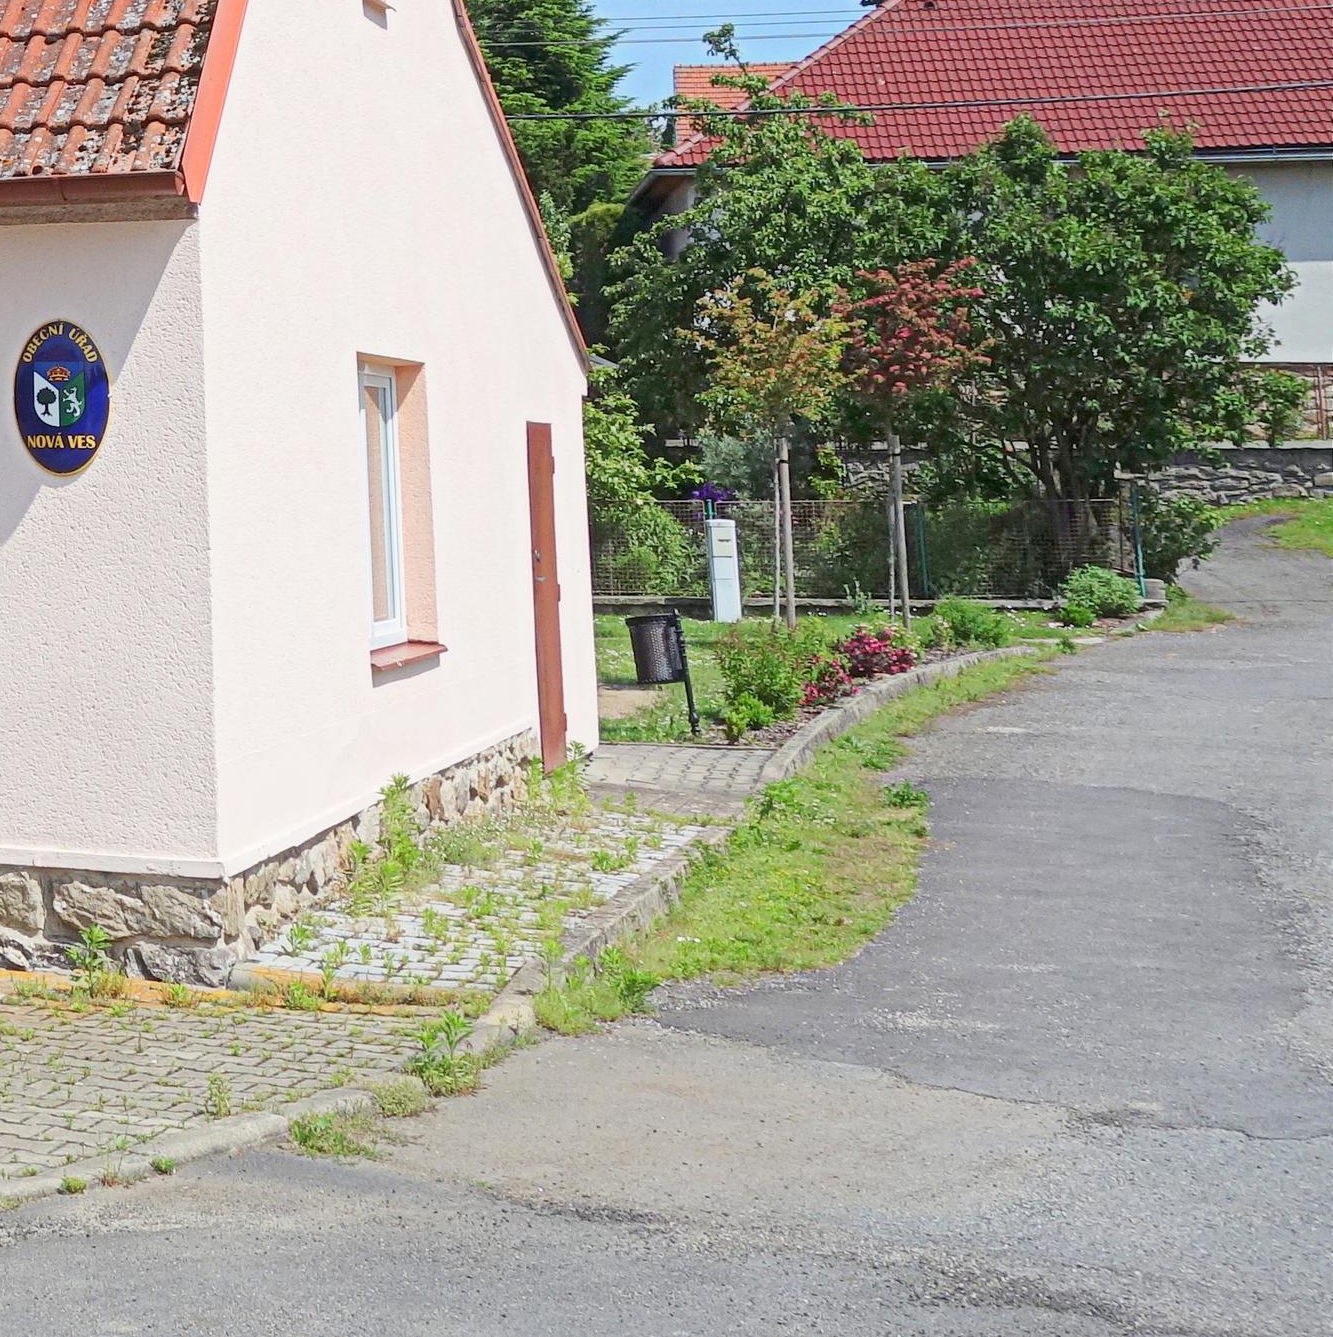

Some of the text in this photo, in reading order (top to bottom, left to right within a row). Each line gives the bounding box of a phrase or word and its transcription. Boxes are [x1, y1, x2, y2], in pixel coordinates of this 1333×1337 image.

[22, 322, 98, 362] OBECNÍ ÚŘAD
[27, 432, 96, 449] NOVÁ VES
